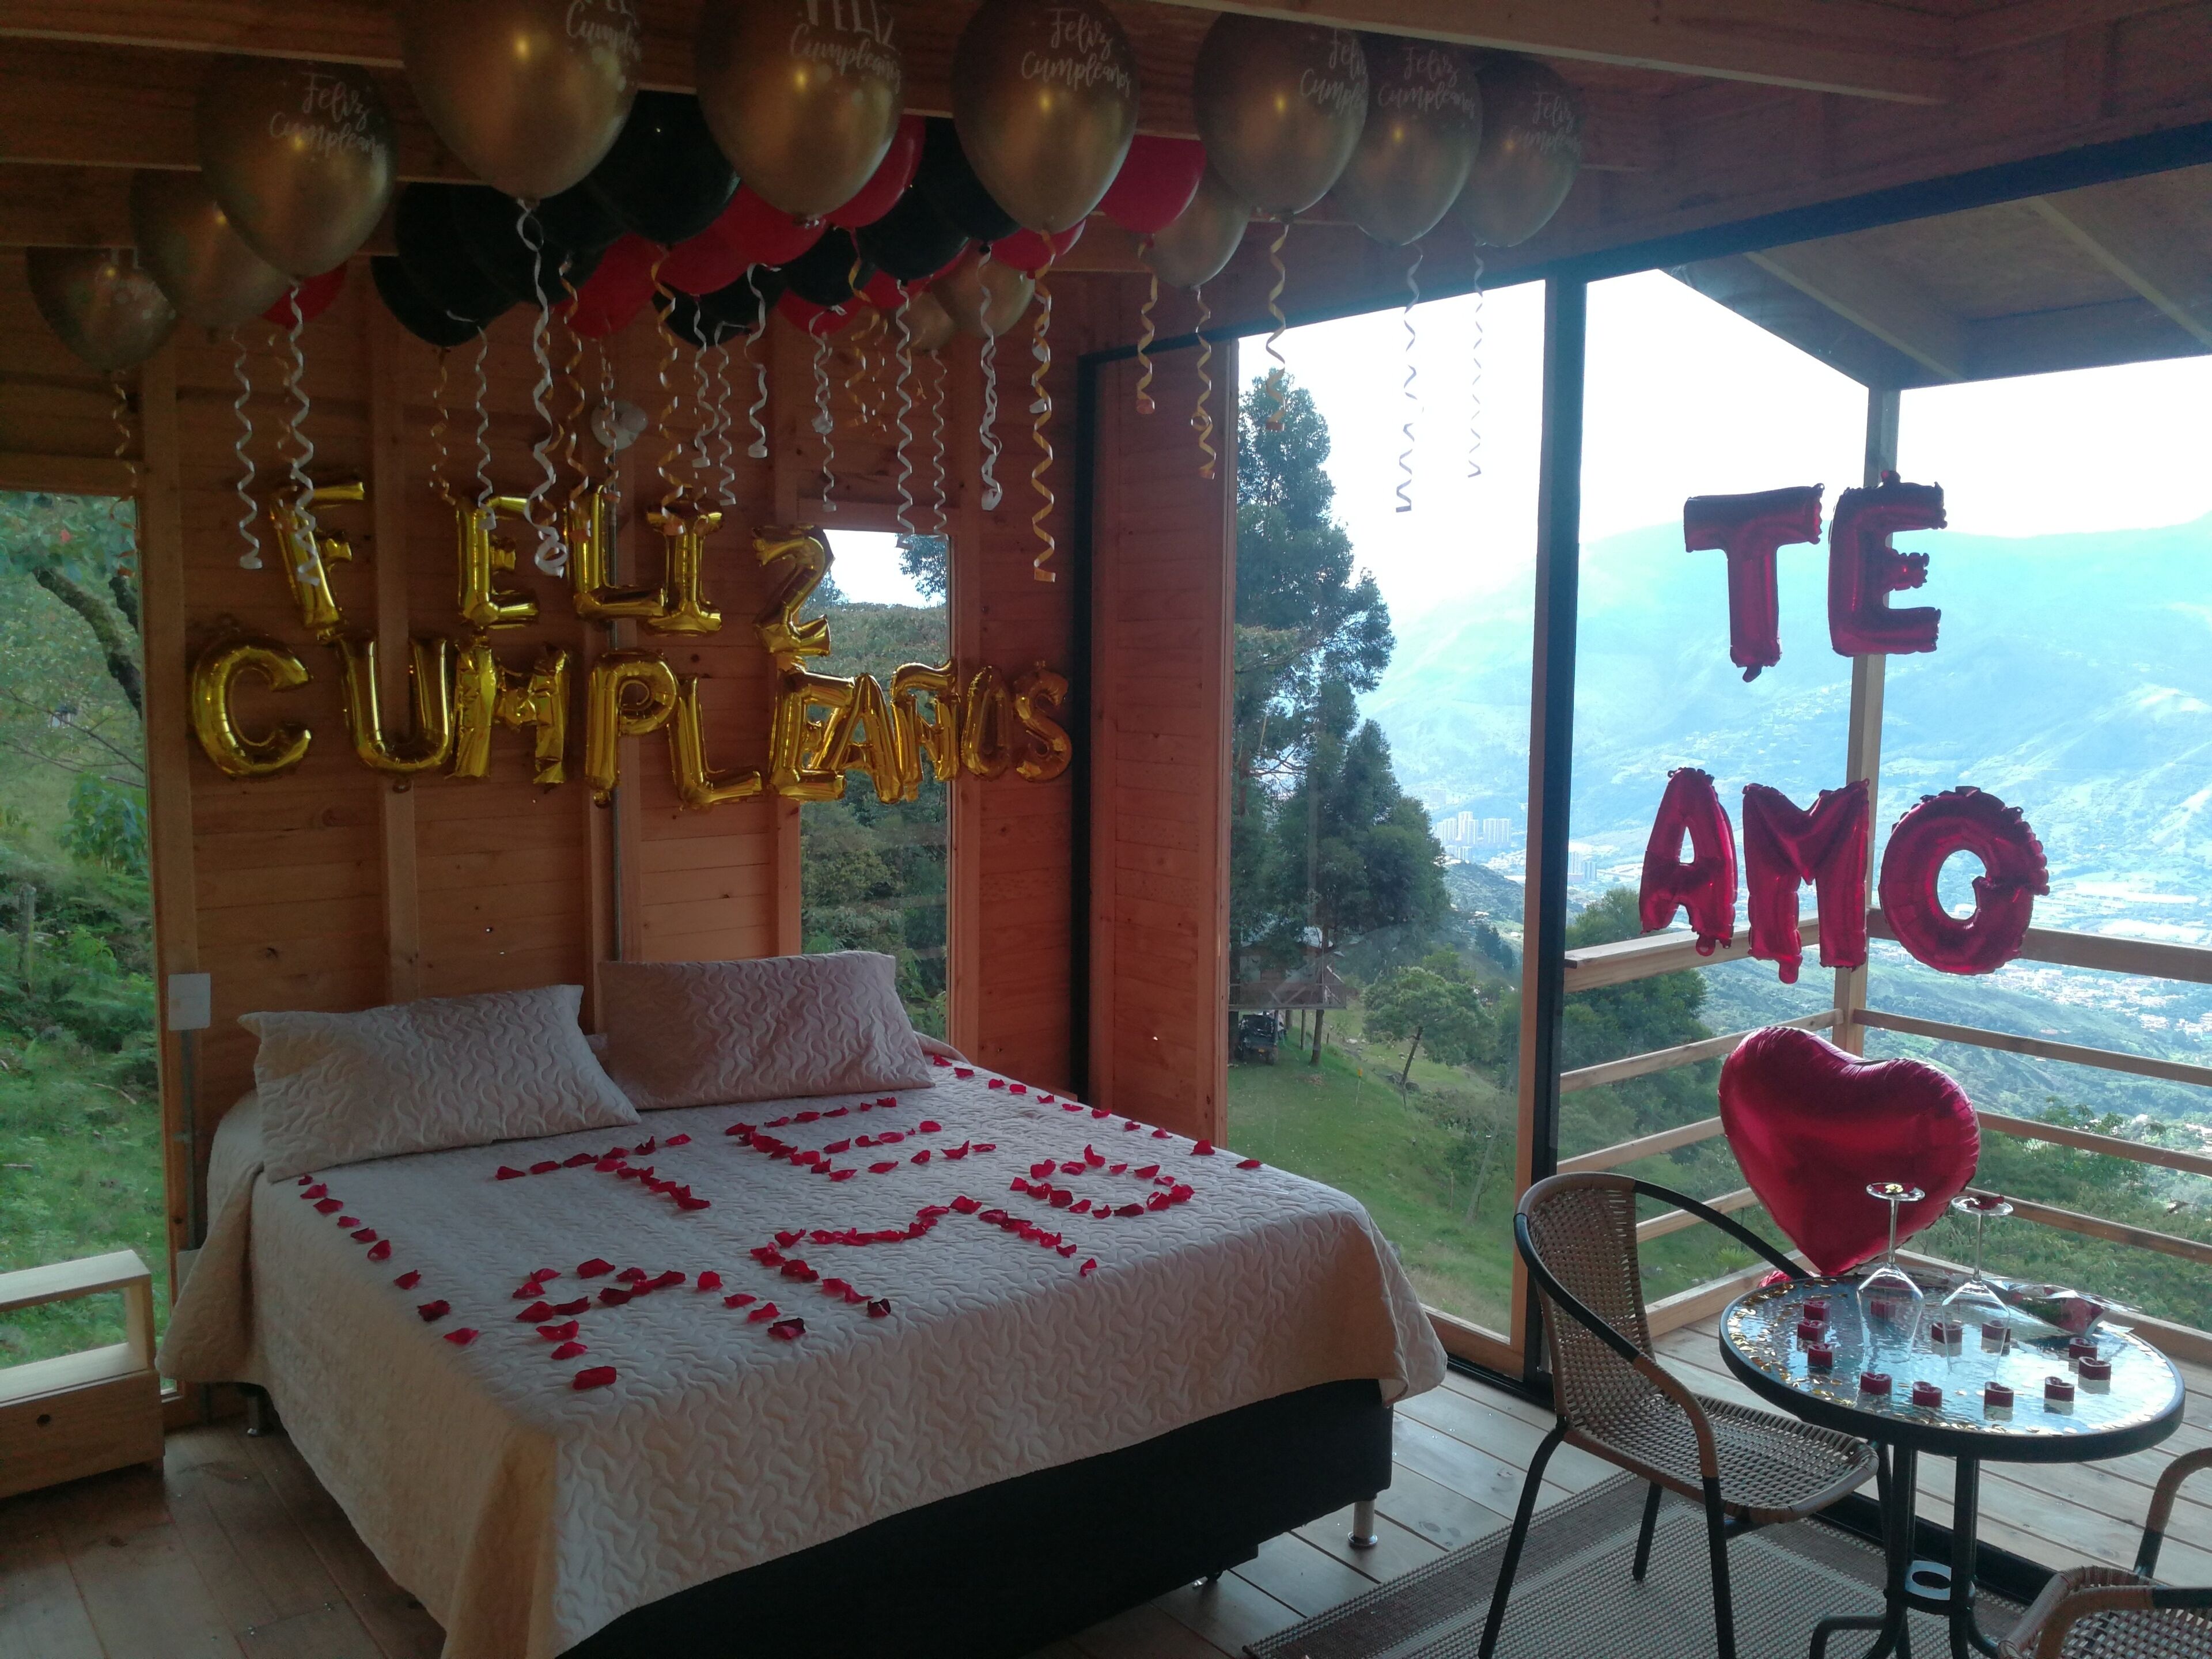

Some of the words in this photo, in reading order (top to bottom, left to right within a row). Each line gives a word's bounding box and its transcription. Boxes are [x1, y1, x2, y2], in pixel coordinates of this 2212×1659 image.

[301, 71, 370, 132] Feliz
[1046, 7, 1115, 61] Feliz
[1683, 471, 1947, 681] TE
[1639, 767, 2049, 984] AMO
